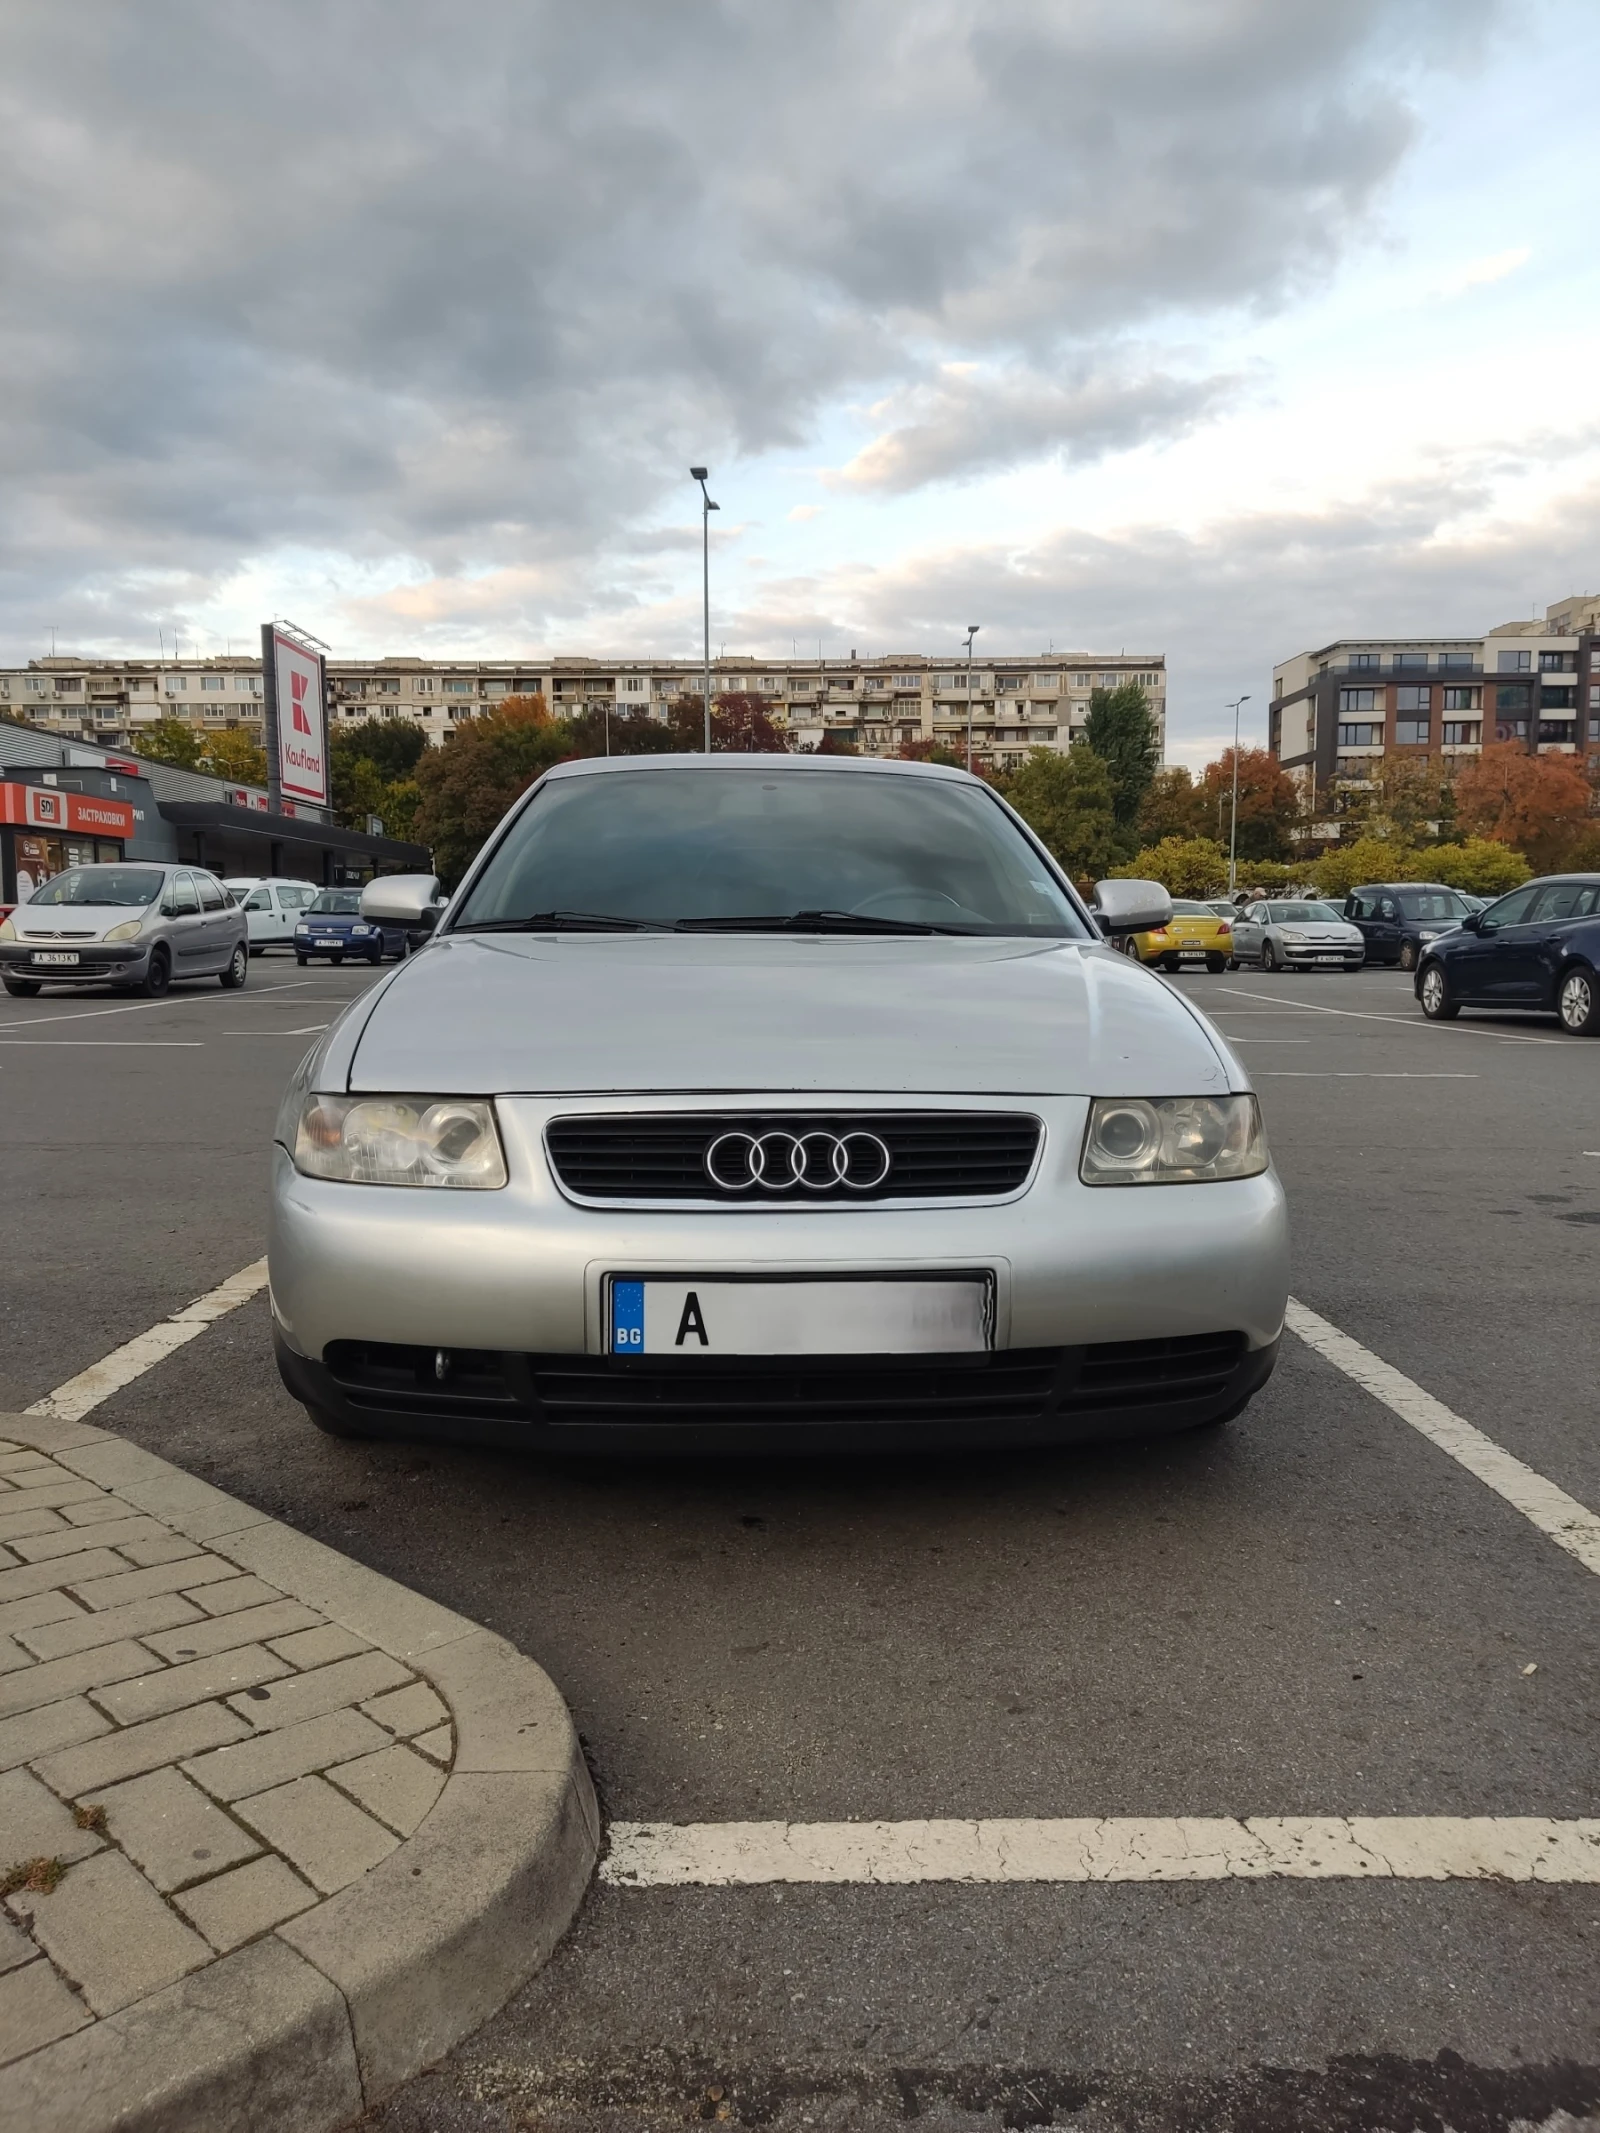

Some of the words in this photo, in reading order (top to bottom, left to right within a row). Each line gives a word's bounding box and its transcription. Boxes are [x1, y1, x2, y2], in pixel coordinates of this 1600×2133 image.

[285, 743, 320, 773] Kaufland
[41, 799, 53, 814] SDI
[77, 807, 125, 827] ЗАСТРАХОВКИ
[675, 1292, 709, 1346] A
[616, 1328, 641, 1345] BG
